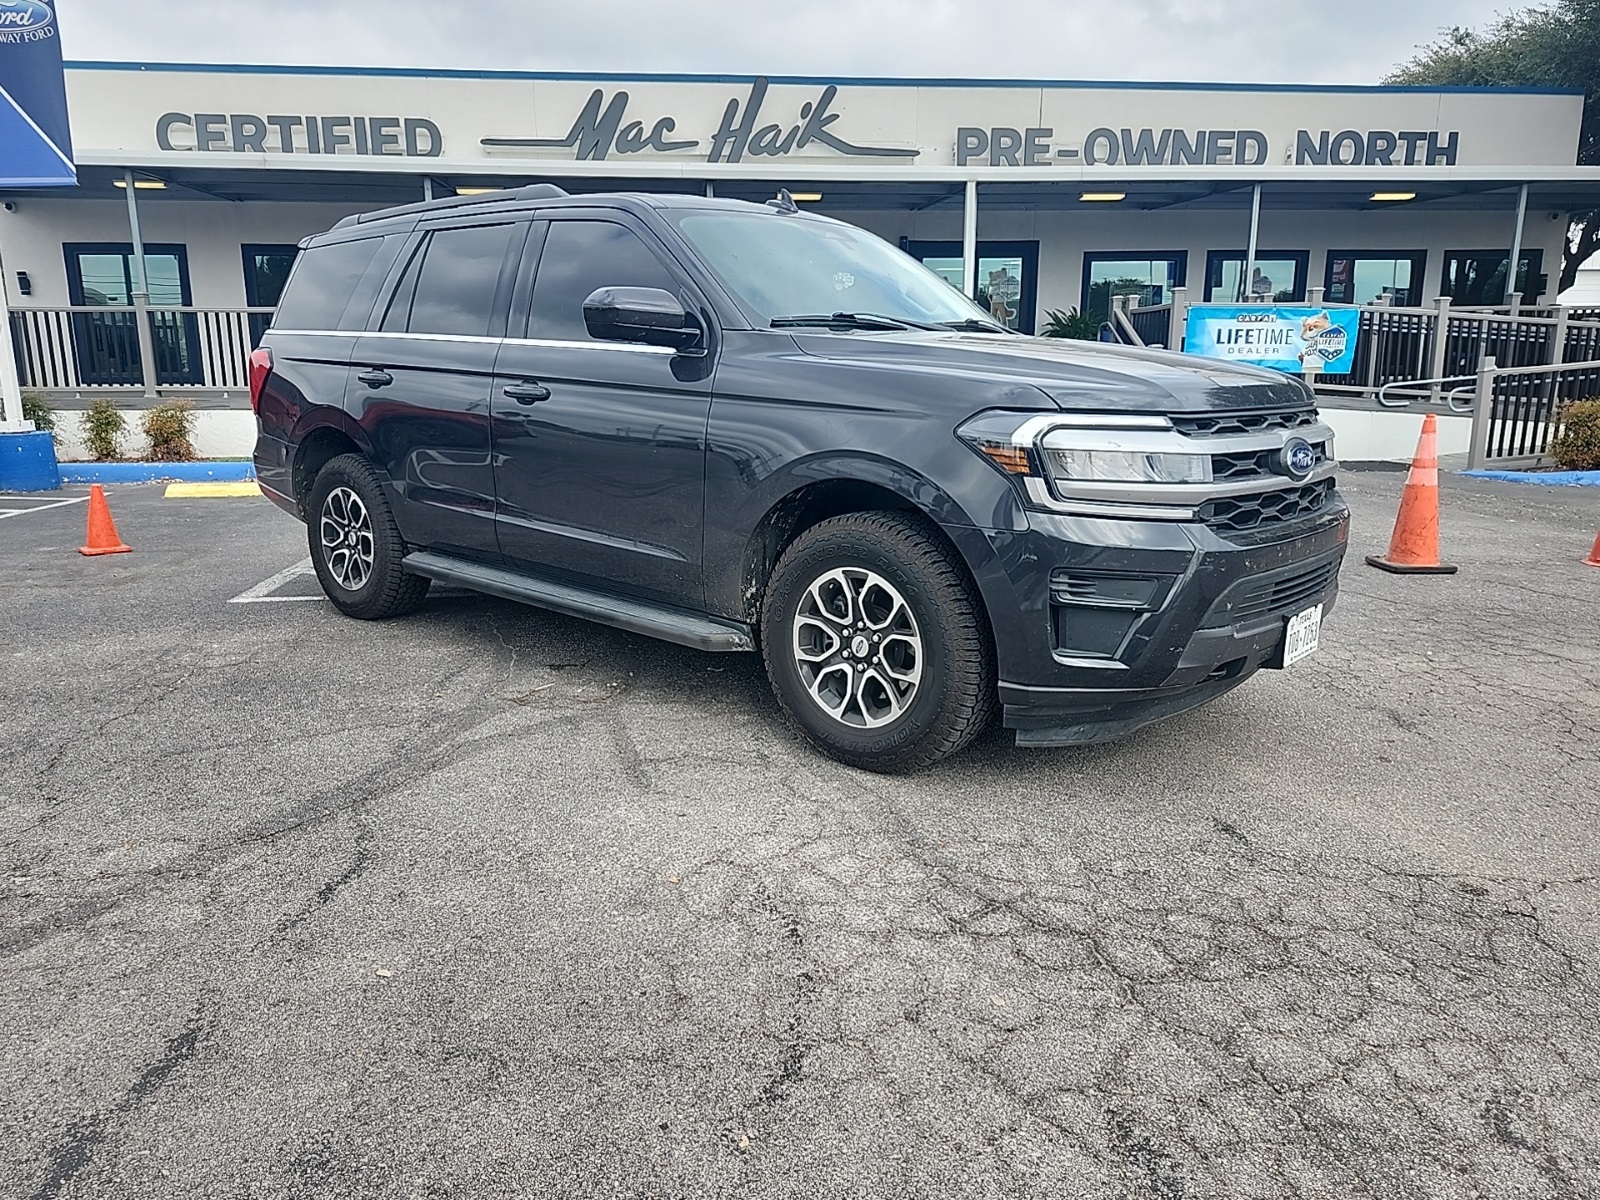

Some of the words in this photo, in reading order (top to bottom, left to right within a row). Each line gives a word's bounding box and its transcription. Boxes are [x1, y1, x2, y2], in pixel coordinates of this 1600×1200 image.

[23, 26, 54, 43] FORD
[156, 112, 442, 157] CERTIFIED
[481, 89, 699, 161] Mac
[707, 76, 919, 163] Haik
[957, 127, 1268, 165] PRE-OWNED
[1297, 130, 1459, 166] NORTH
[1216, 328, 1294, 345] LIFETIME
